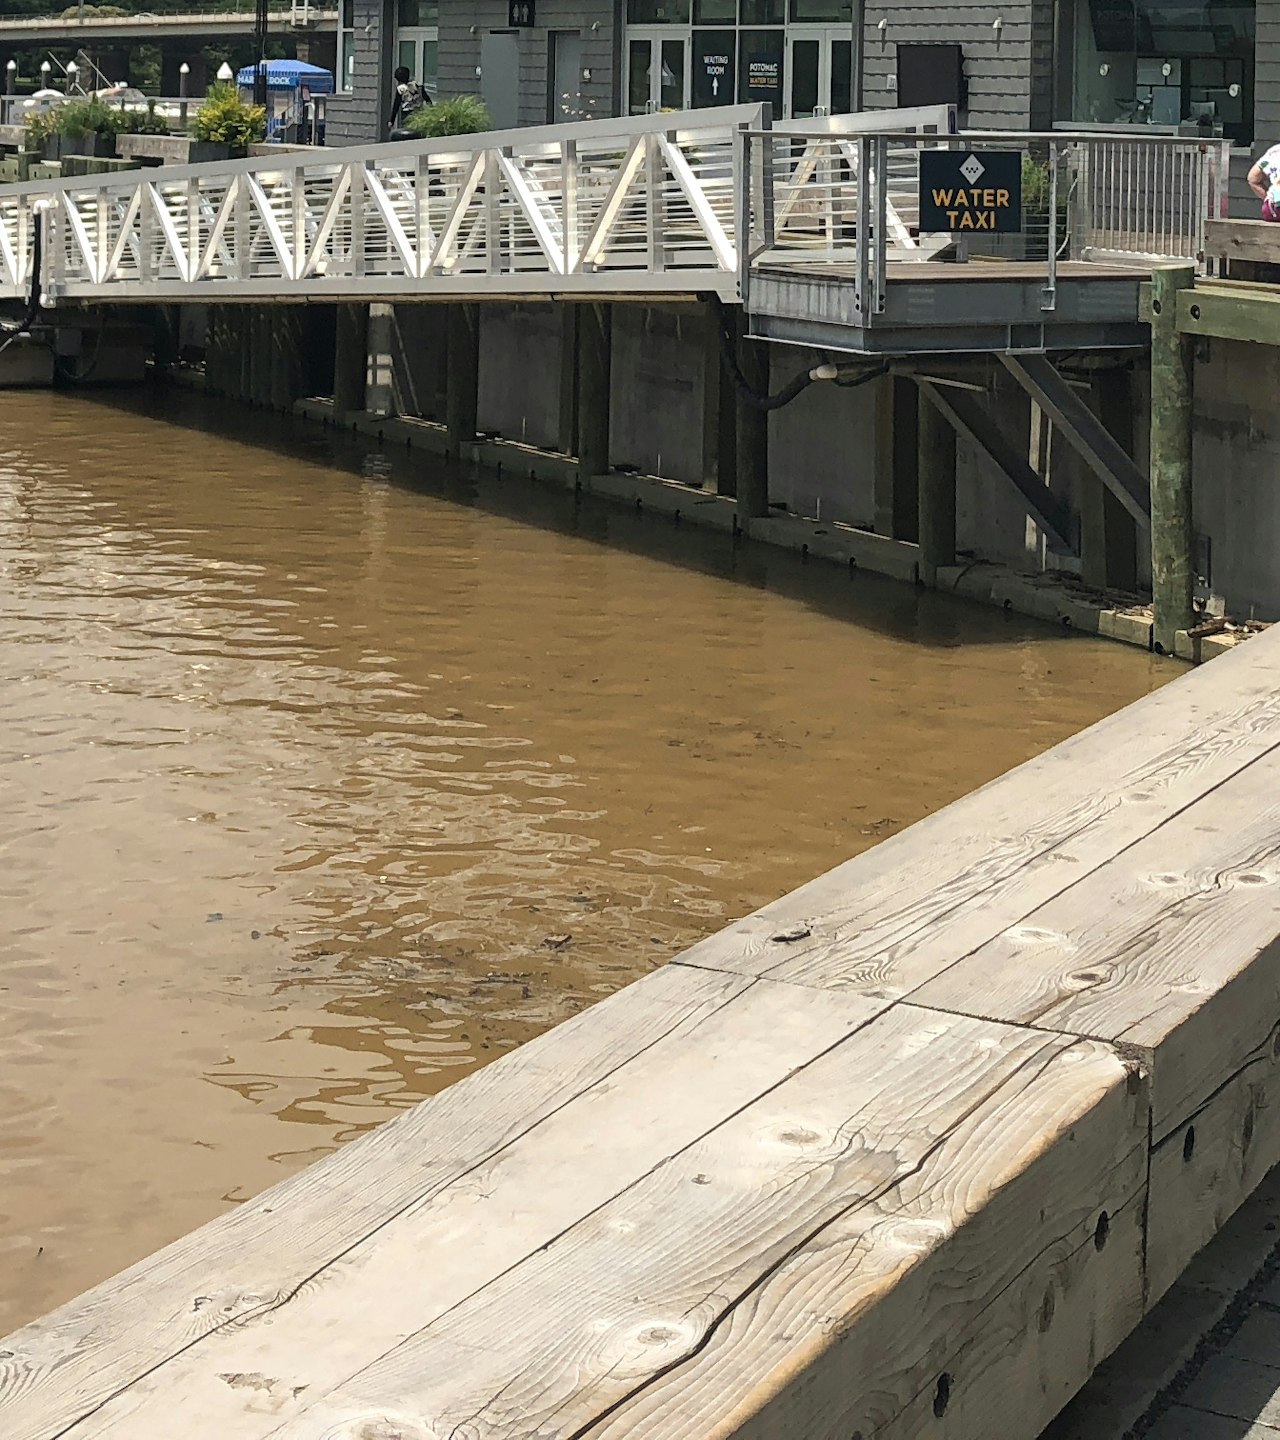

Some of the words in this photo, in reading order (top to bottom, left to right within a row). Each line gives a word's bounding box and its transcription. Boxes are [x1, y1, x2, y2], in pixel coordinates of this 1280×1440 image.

[706, 66, 725, 75] ROOM
[749, 63, 778, 72] POTOMAC
[269, 76, 291, 85] DOCK
[931, 188, 1010, 208] WATER
[945, 210, 996, 230] TAXI
